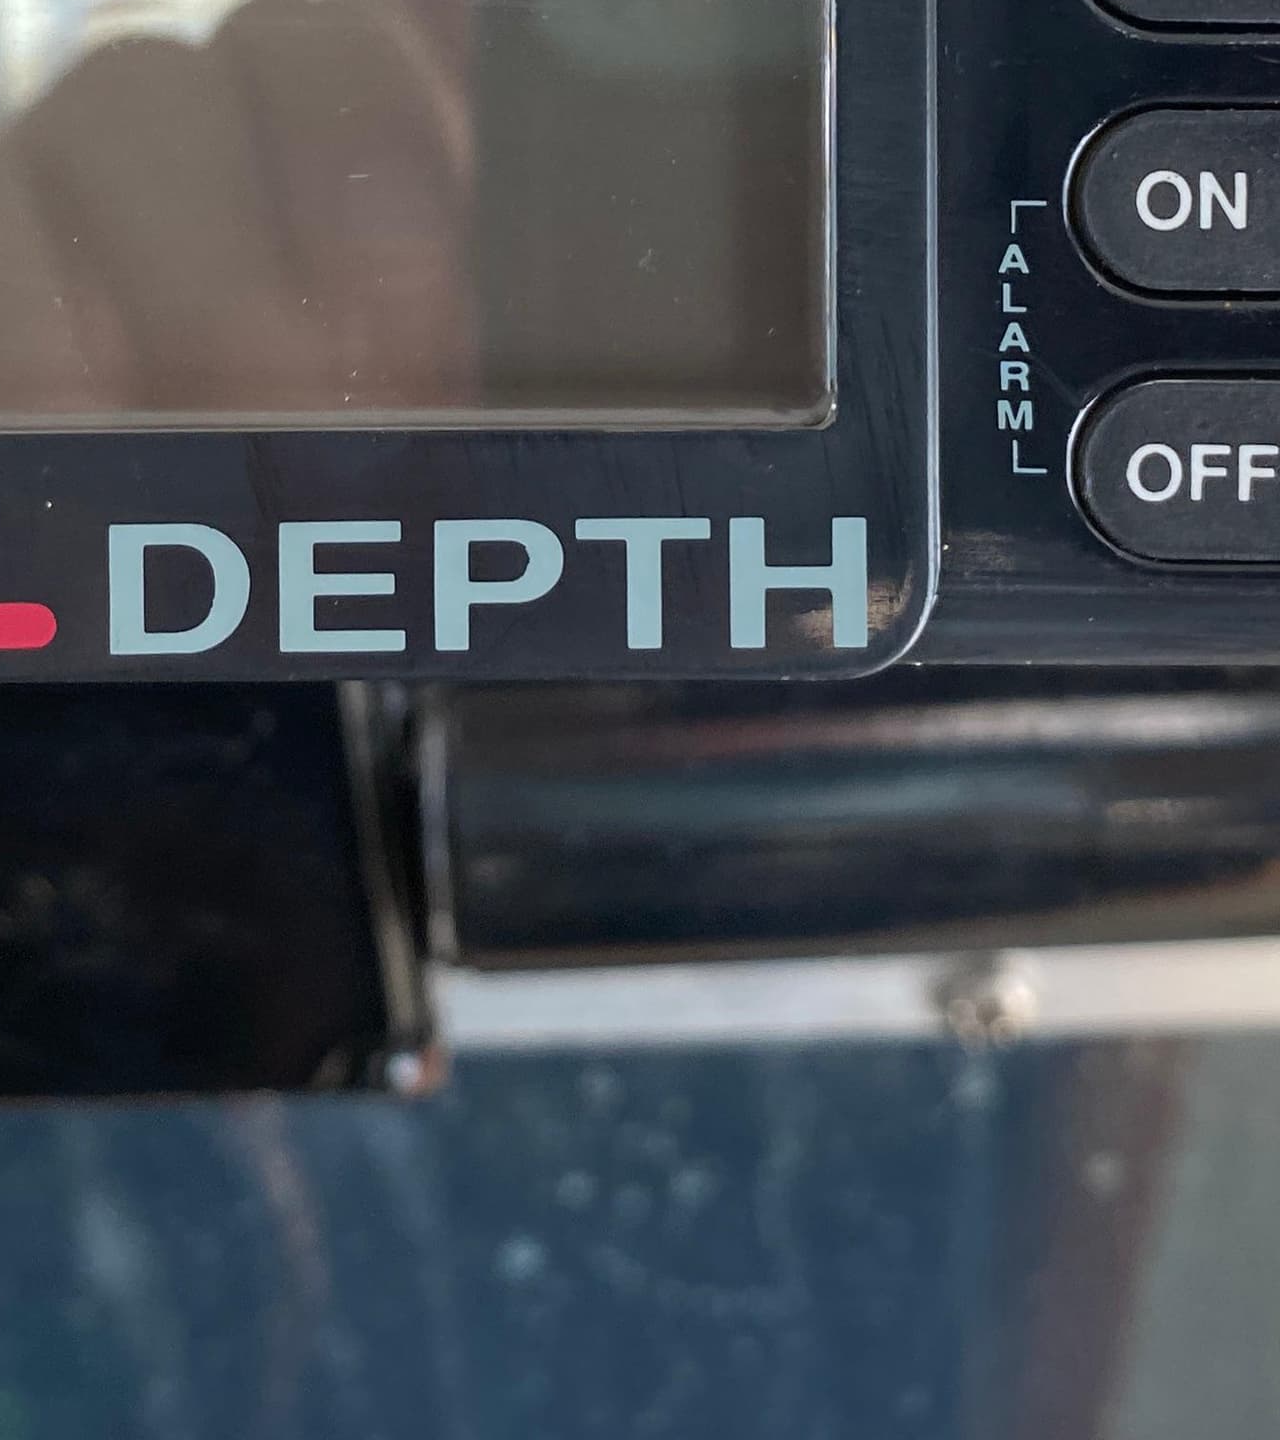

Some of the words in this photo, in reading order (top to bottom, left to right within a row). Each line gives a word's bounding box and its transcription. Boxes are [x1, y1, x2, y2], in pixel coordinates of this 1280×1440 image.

[1135, 170, 1248, 231] ON
[997, 243, 1033, 431] ALARM
[1125, 443, 1280, 502] OFF
[108, 517, 869, 656] DEPTH
